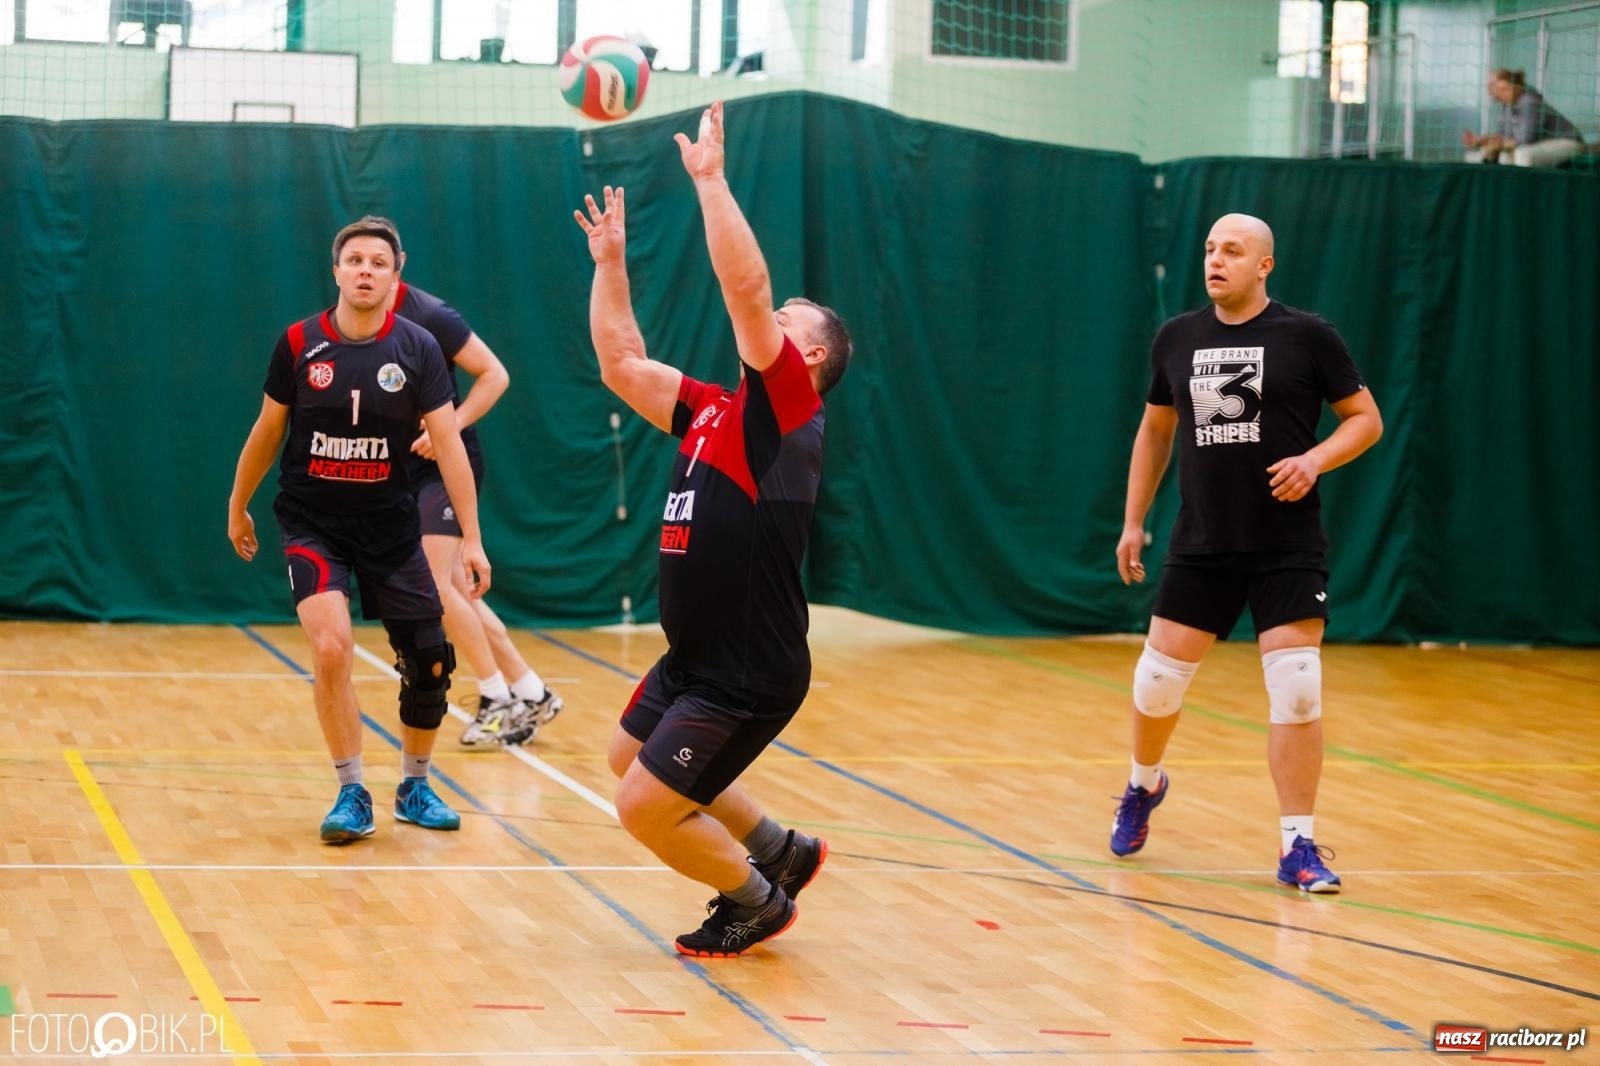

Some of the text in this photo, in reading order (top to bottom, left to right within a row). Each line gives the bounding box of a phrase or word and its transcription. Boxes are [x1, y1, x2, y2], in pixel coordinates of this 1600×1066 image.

[1197, 349, 1258, 361] THE BRAND
[1194, 364, 1220, 376] WITH
[1193, 382, 1212, 393] THE
[351, 389, 361, 426] 1
[1195, 422, 1261, 446] STRIPES
[685, 435, 706, 477] 1
